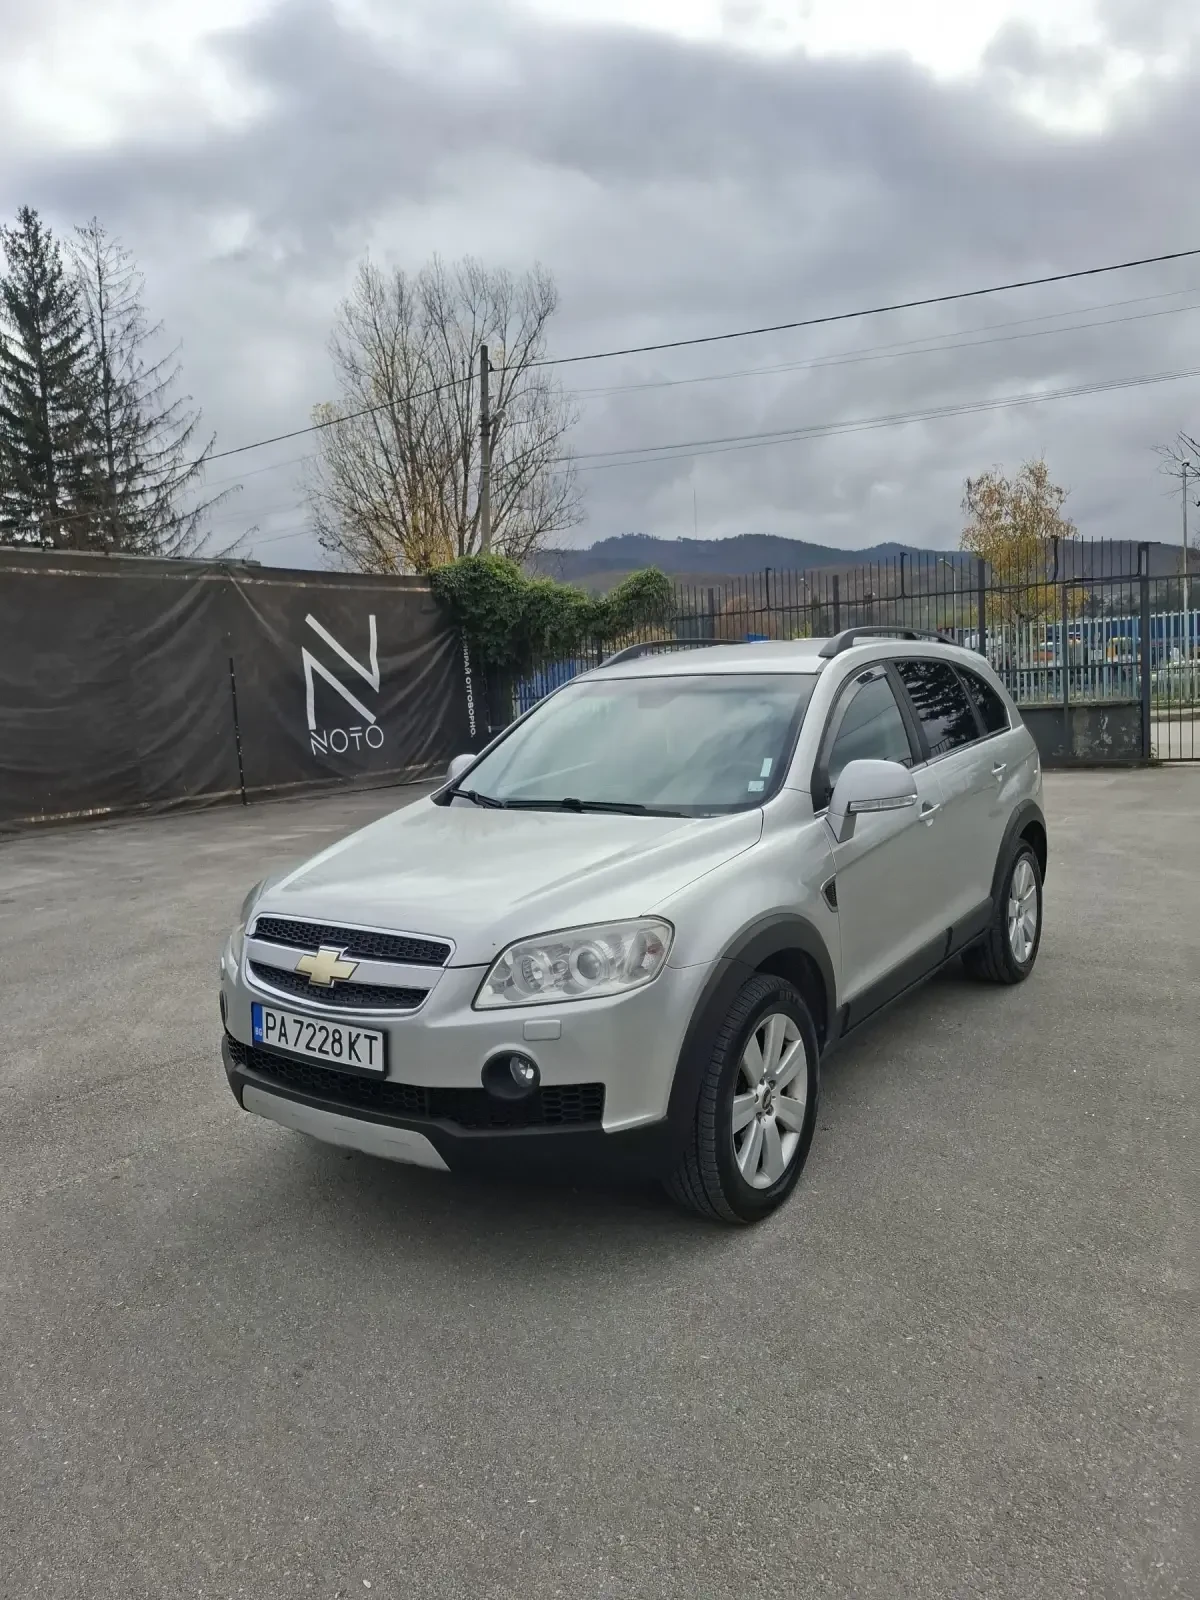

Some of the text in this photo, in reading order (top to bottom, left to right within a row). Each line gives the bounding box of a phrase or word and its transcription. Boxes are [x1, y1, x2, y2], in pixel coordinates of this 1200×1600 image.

[465, 677, 477, 738] ОТГОВОРНО.
[310, 724, 385, 756] NOTO
[254, 1027, 263, 1037] BG
[265, 1011, 378, 1065] PA 7228 KT
